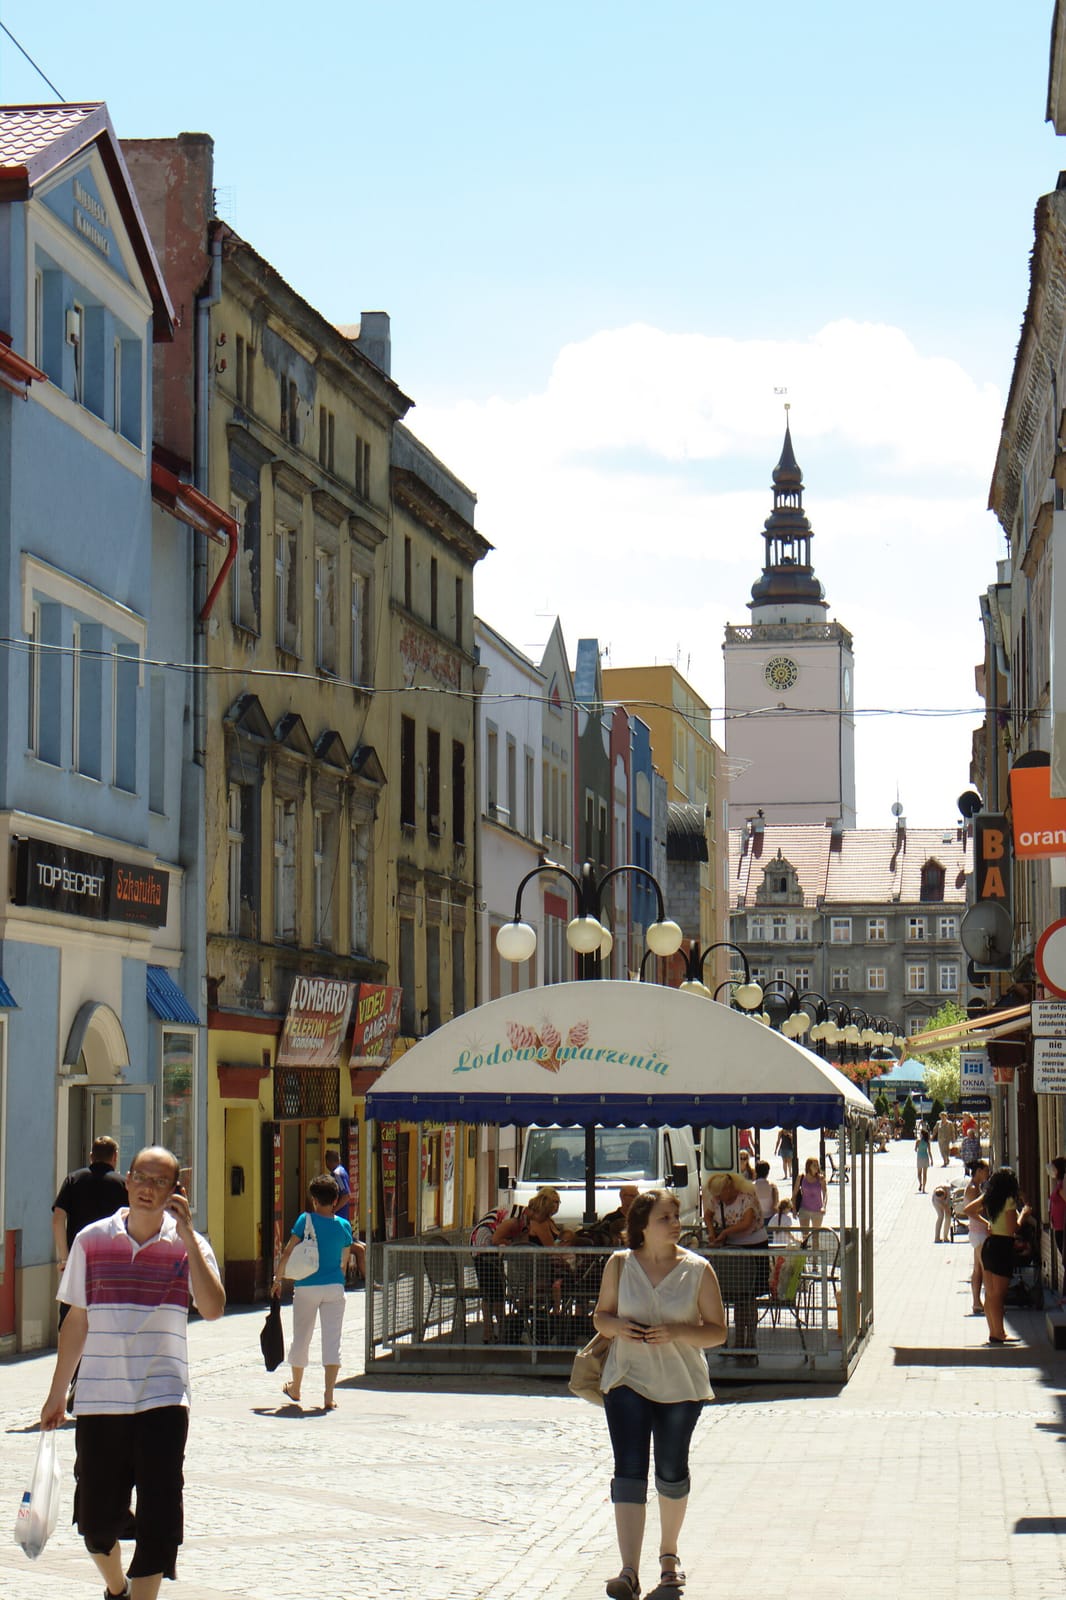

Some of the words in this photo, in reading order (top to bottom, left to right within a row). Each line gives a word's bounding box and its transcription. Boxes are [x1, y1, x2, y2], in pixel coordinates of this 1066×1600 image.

[37, 863, 61, 890] TOP
[62, 868, 105, 897] SECRET
[981, 828, 1006, 898] BA
[290, 977, 347, 1016] LOMBARD
[359, 989, 385, 1024] VIDEO
[285, 1015, 328, 1037] TELEFONY
[363, 1014, 388, 1045] GAMES
[452, 1043, 548, 1074] Lodowe
[555, 1046, 670, 1077] marzenia
[1049, 1041, 1063, 1049] nie
[962, 1079, 985, 1087] OKNA
